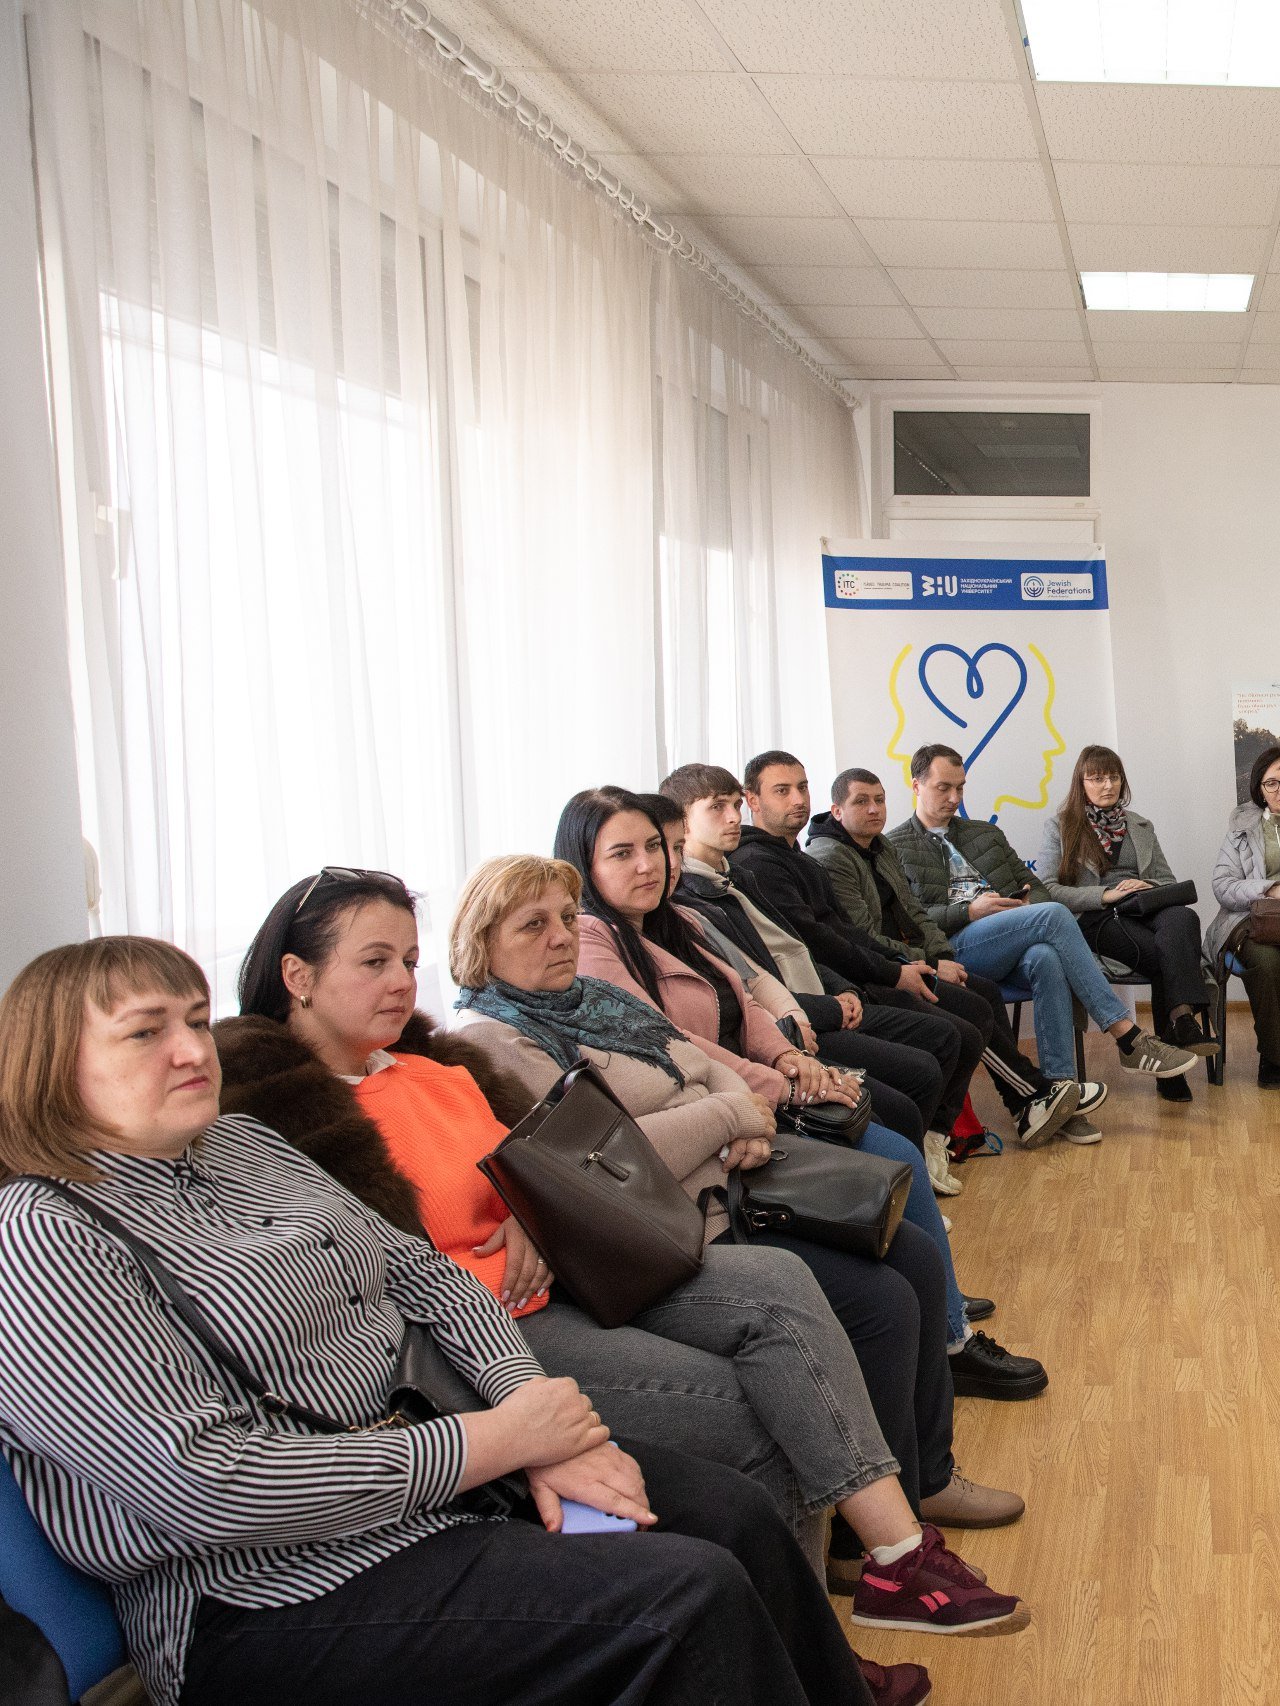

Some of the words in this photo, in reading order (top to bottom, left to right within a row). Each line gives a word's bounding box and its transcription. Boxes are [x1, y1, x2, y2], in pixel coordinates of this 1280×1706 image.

[843, 580, 855, 589] ITC
[1047, 579, 1072, 587] Jewish
[1047, 587, 1092, 595] Federations
